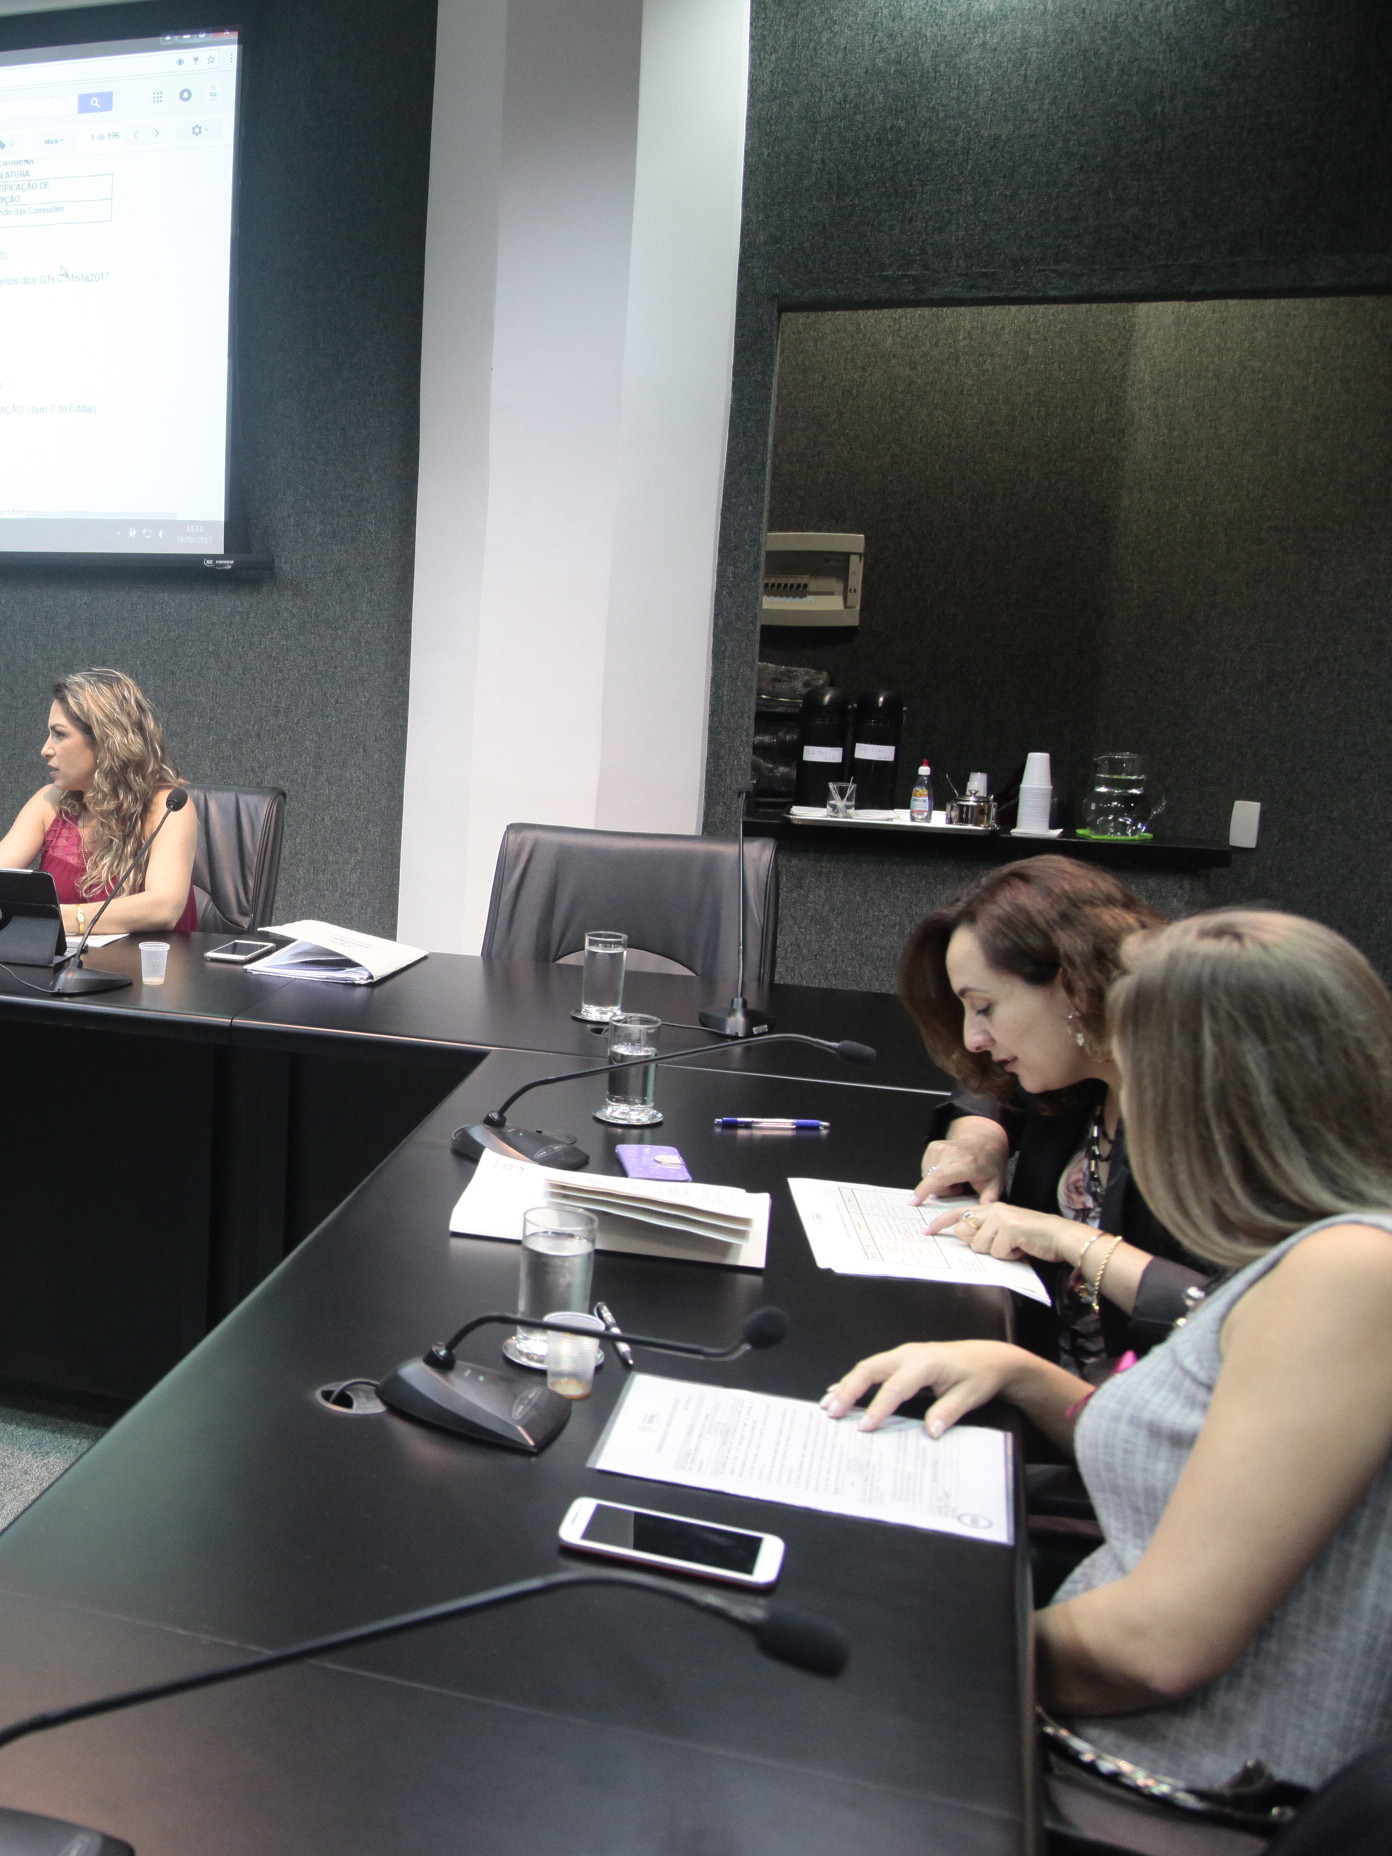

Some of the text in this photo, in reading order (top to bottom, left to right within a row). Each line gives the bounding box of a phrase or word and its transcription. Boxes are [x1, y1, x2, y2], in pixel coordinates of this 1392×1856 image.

[108, 132, 120, 140] 196
[14, 207, 26, 215] das
[28, 206, 64, 214] Comissões
[21, 276, 37, 285] dos
[39, 275, 55, 284] GTs
[27, 405, 48, 415] (item
[57, 405, 67, 413] do
